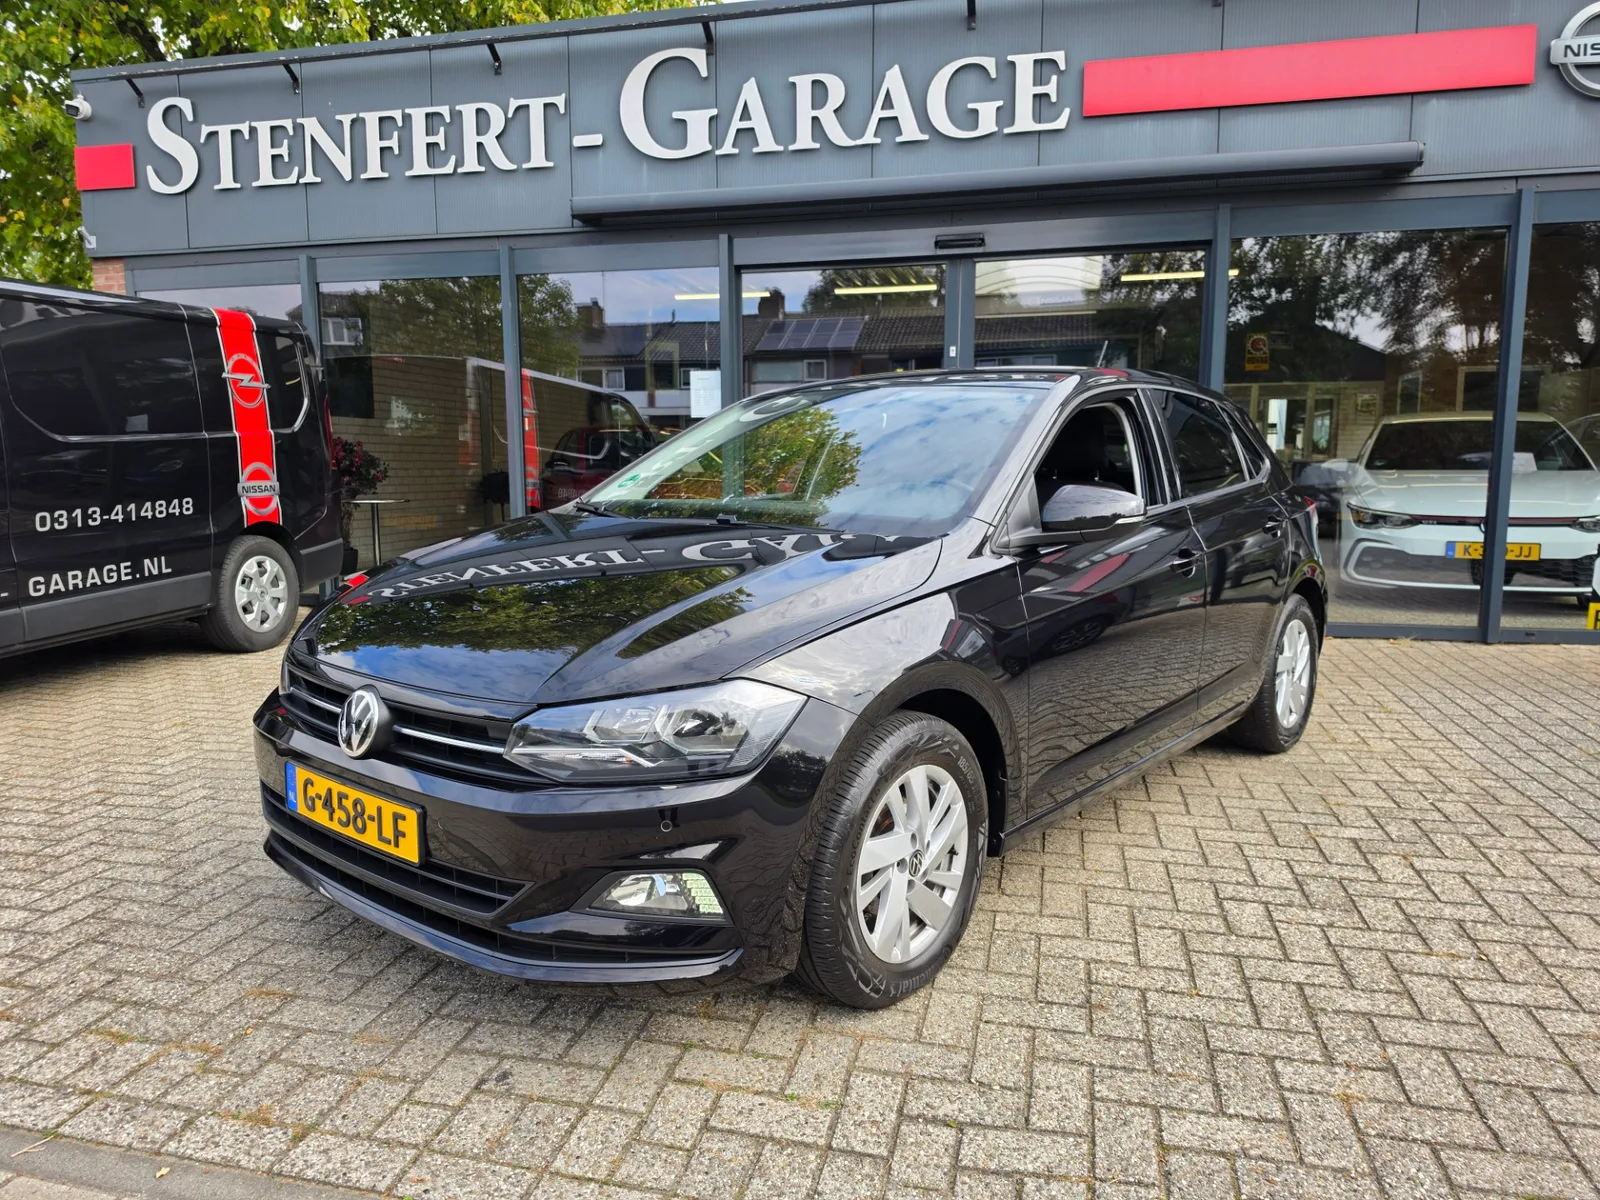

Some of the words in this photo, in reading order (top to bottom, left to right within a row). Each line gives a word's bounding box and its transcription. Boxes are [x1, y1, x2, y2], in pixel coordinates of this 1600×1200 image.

[1564, 42, 1600, 58] NIS
[241, 484, 276, 494] NISSAN
[35, 497, 194, 532] 0313-414848
[303, 777, 406, 848] G-458-LF
